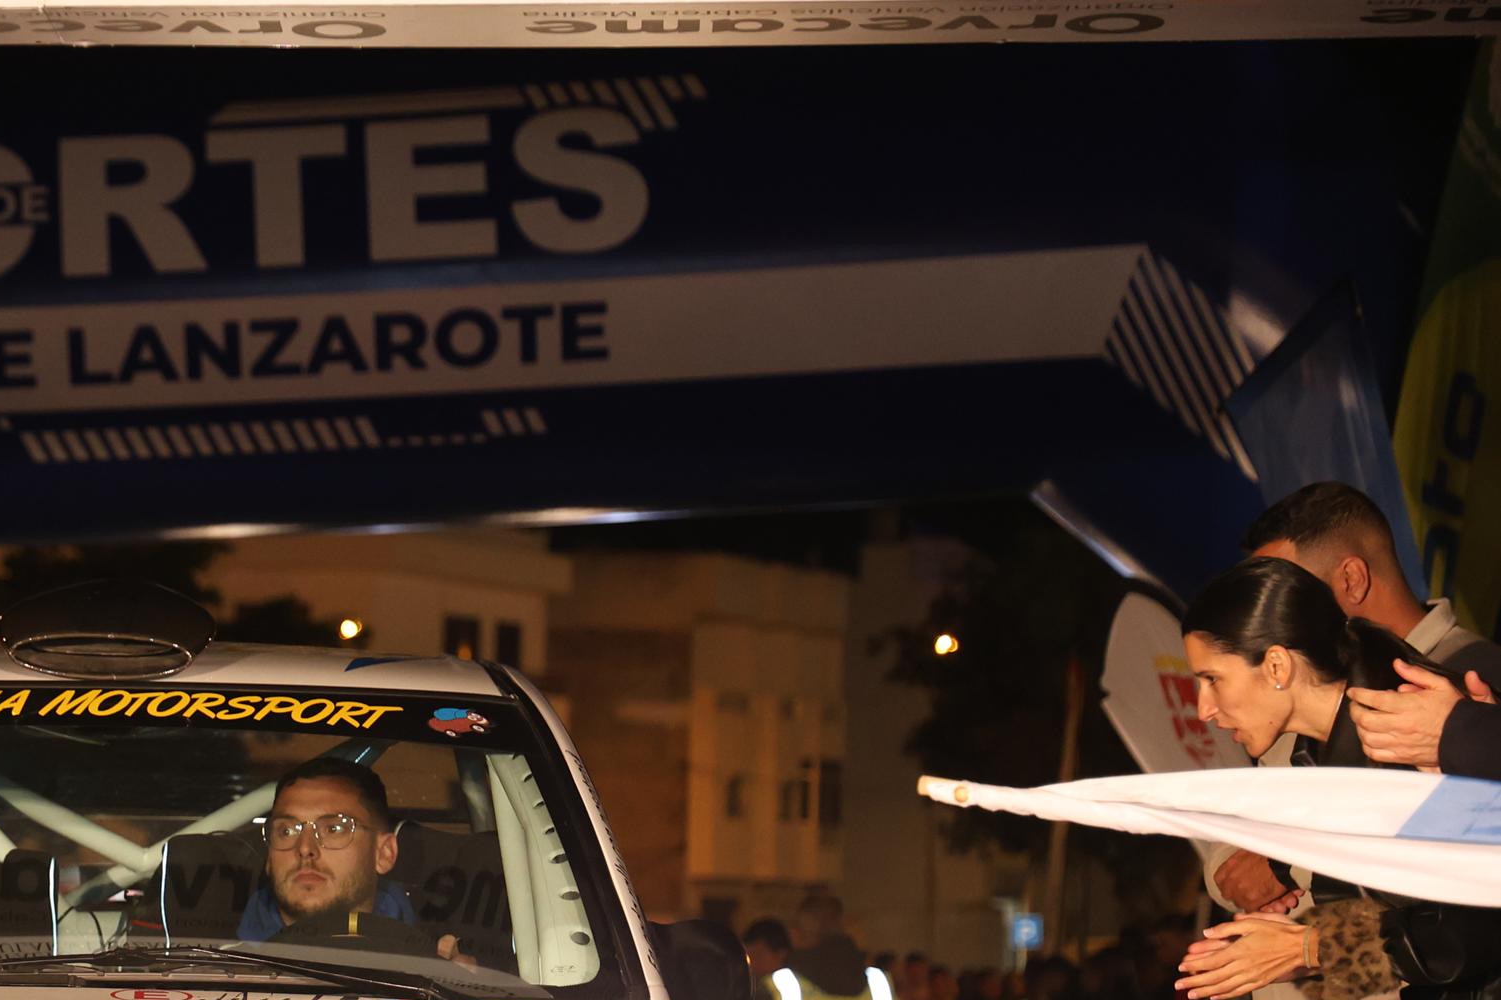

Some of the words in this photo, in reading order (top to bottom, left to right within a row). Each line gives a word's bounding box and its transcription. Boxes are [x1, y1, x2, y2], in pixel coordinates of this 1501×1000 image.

[524, 12, 1166, 34] Orvecame
[68, 302, 610, 386] LANZAROTE
[38, 689, 404, 729] MOTORSPORT
